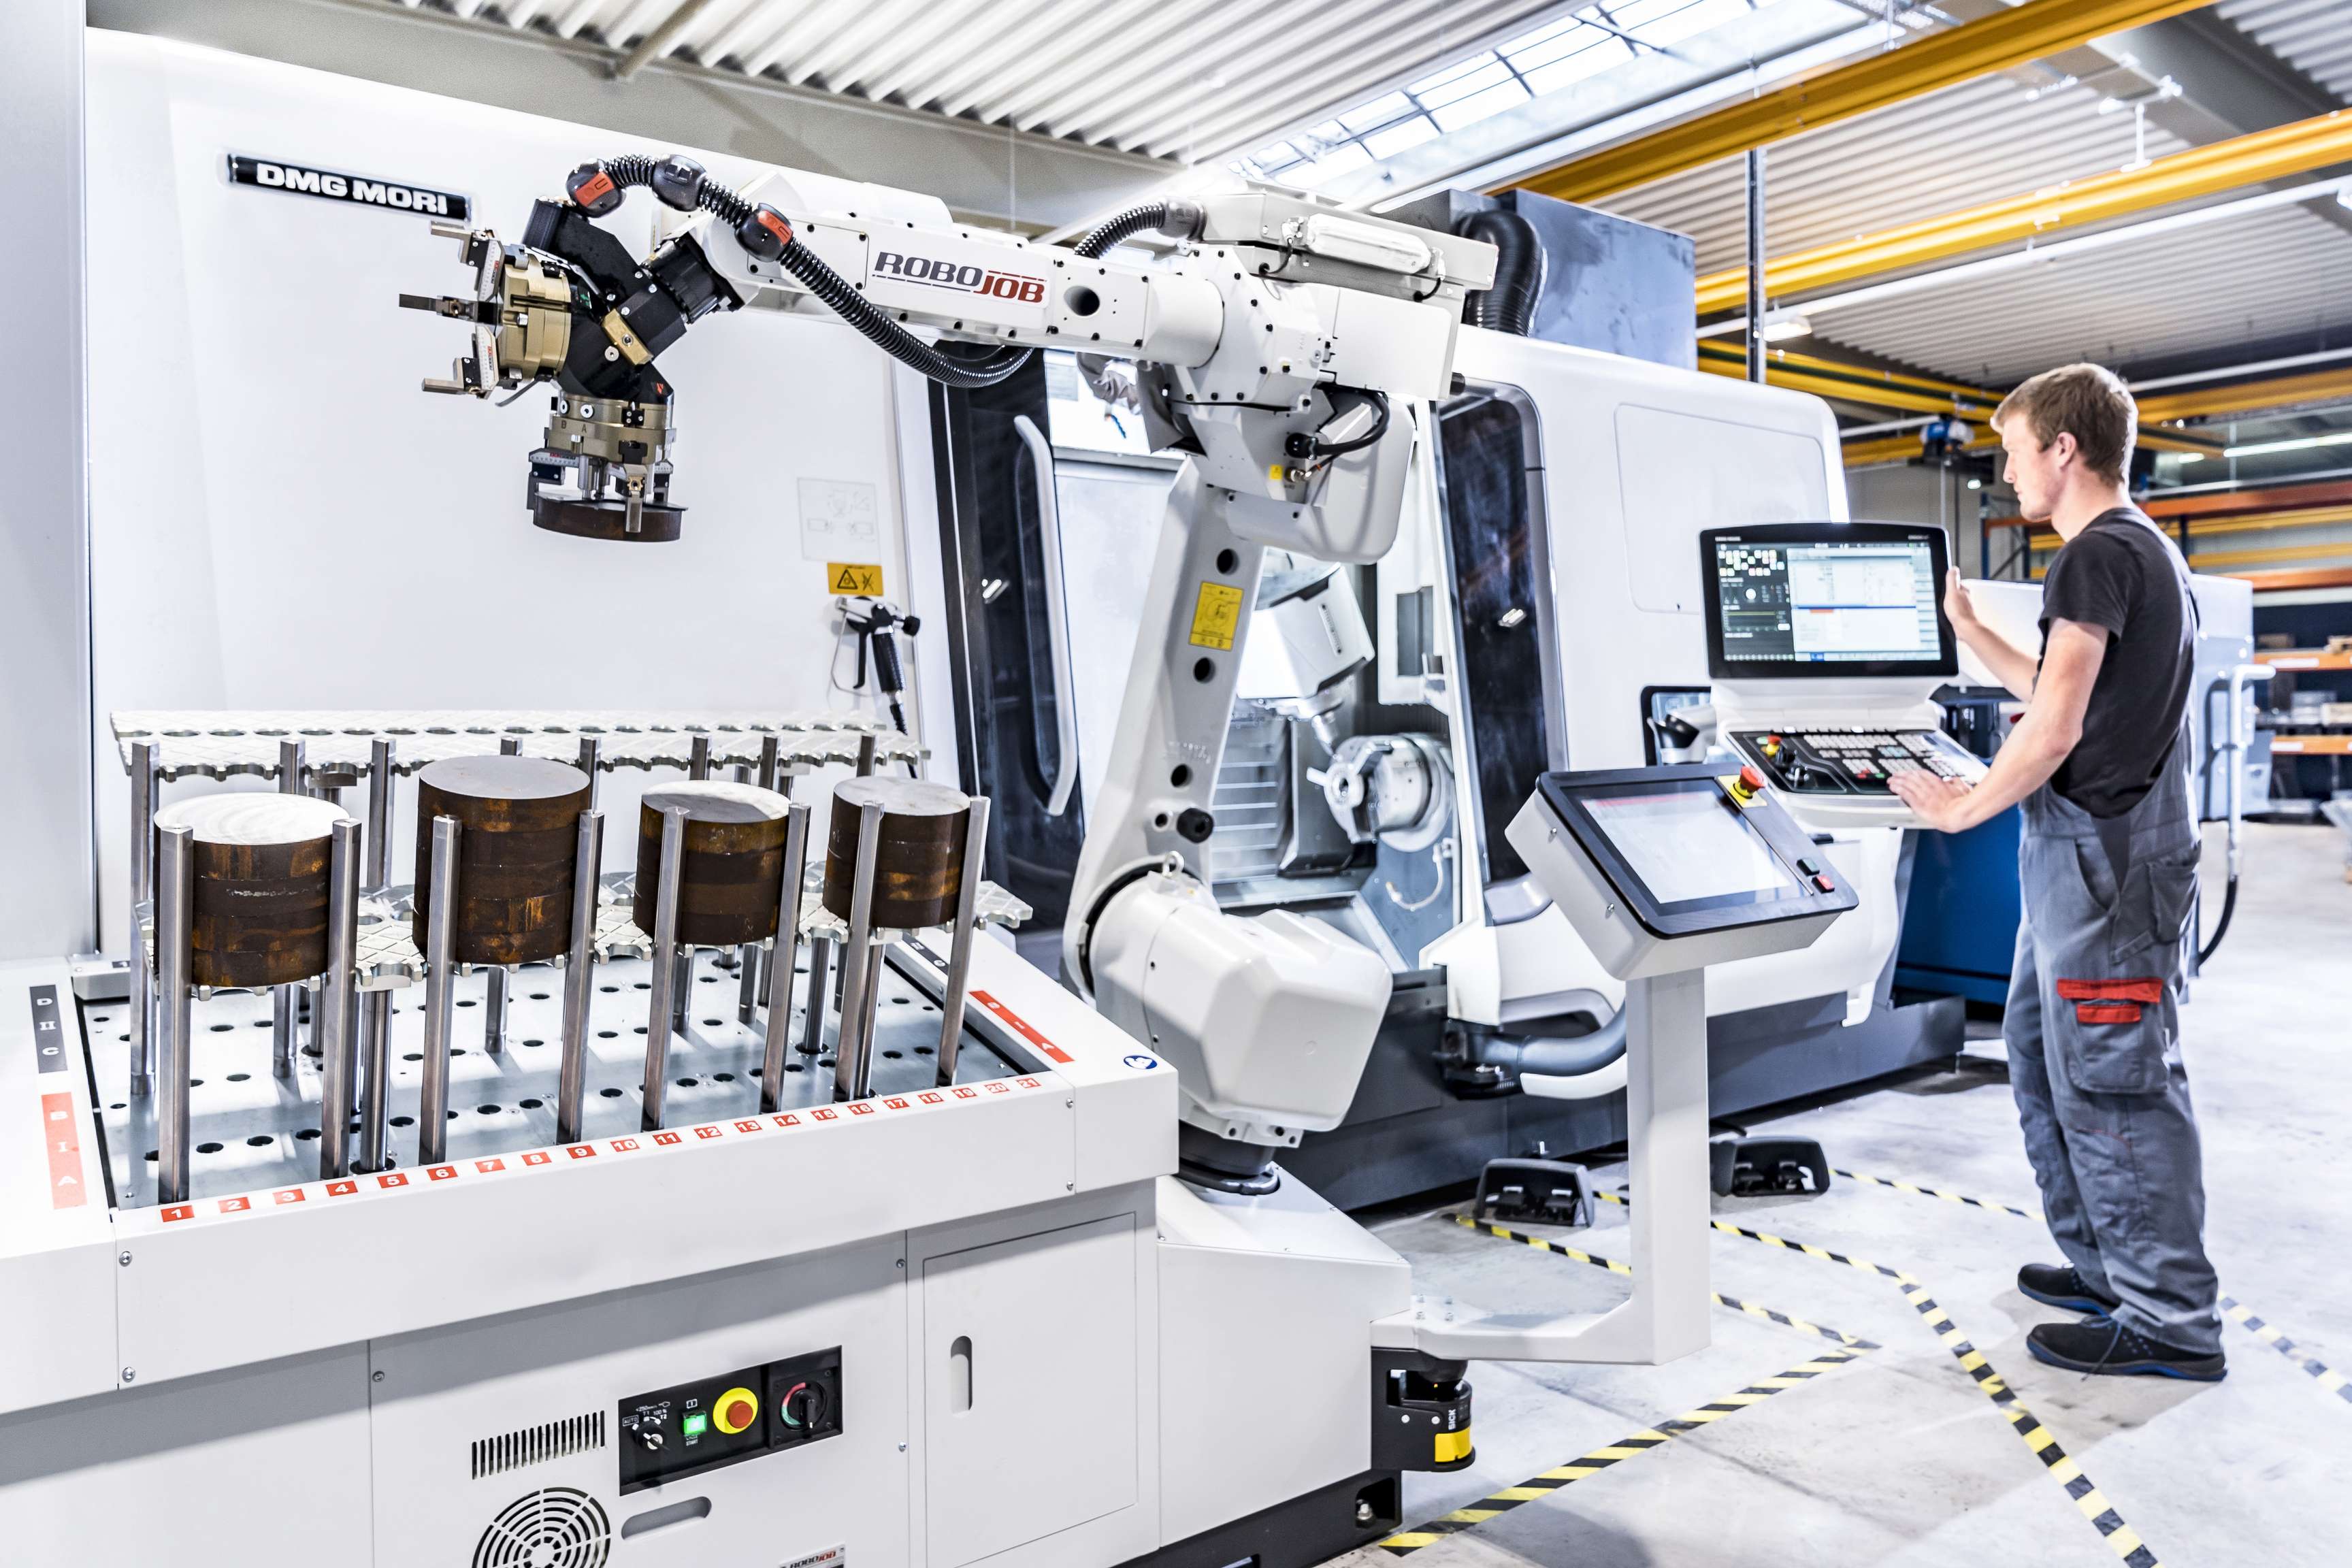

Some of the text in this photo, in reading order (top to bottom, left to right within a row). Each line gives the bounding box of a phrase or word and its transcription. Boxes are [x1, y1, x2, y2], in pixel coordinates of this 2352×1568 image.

[256, 163, 448, 215] DMG MORI
[874, 251, 1045, 304] ROBOJOB
[561, 420, 587, 434] B A
[36, 998, 53, 1006] D
[42, 1047, 59, 1056] C
[1041, 1042, 1055, 1050] A
[171, 1078, 1038, 1218] 1 2 3 4 5 6 7 8 9 10 11 12 13 14 15 16 17 18 19 20 21
[57, 1175, 78, 1187] A
[1448, 1409, 1456, 1431] SICK
